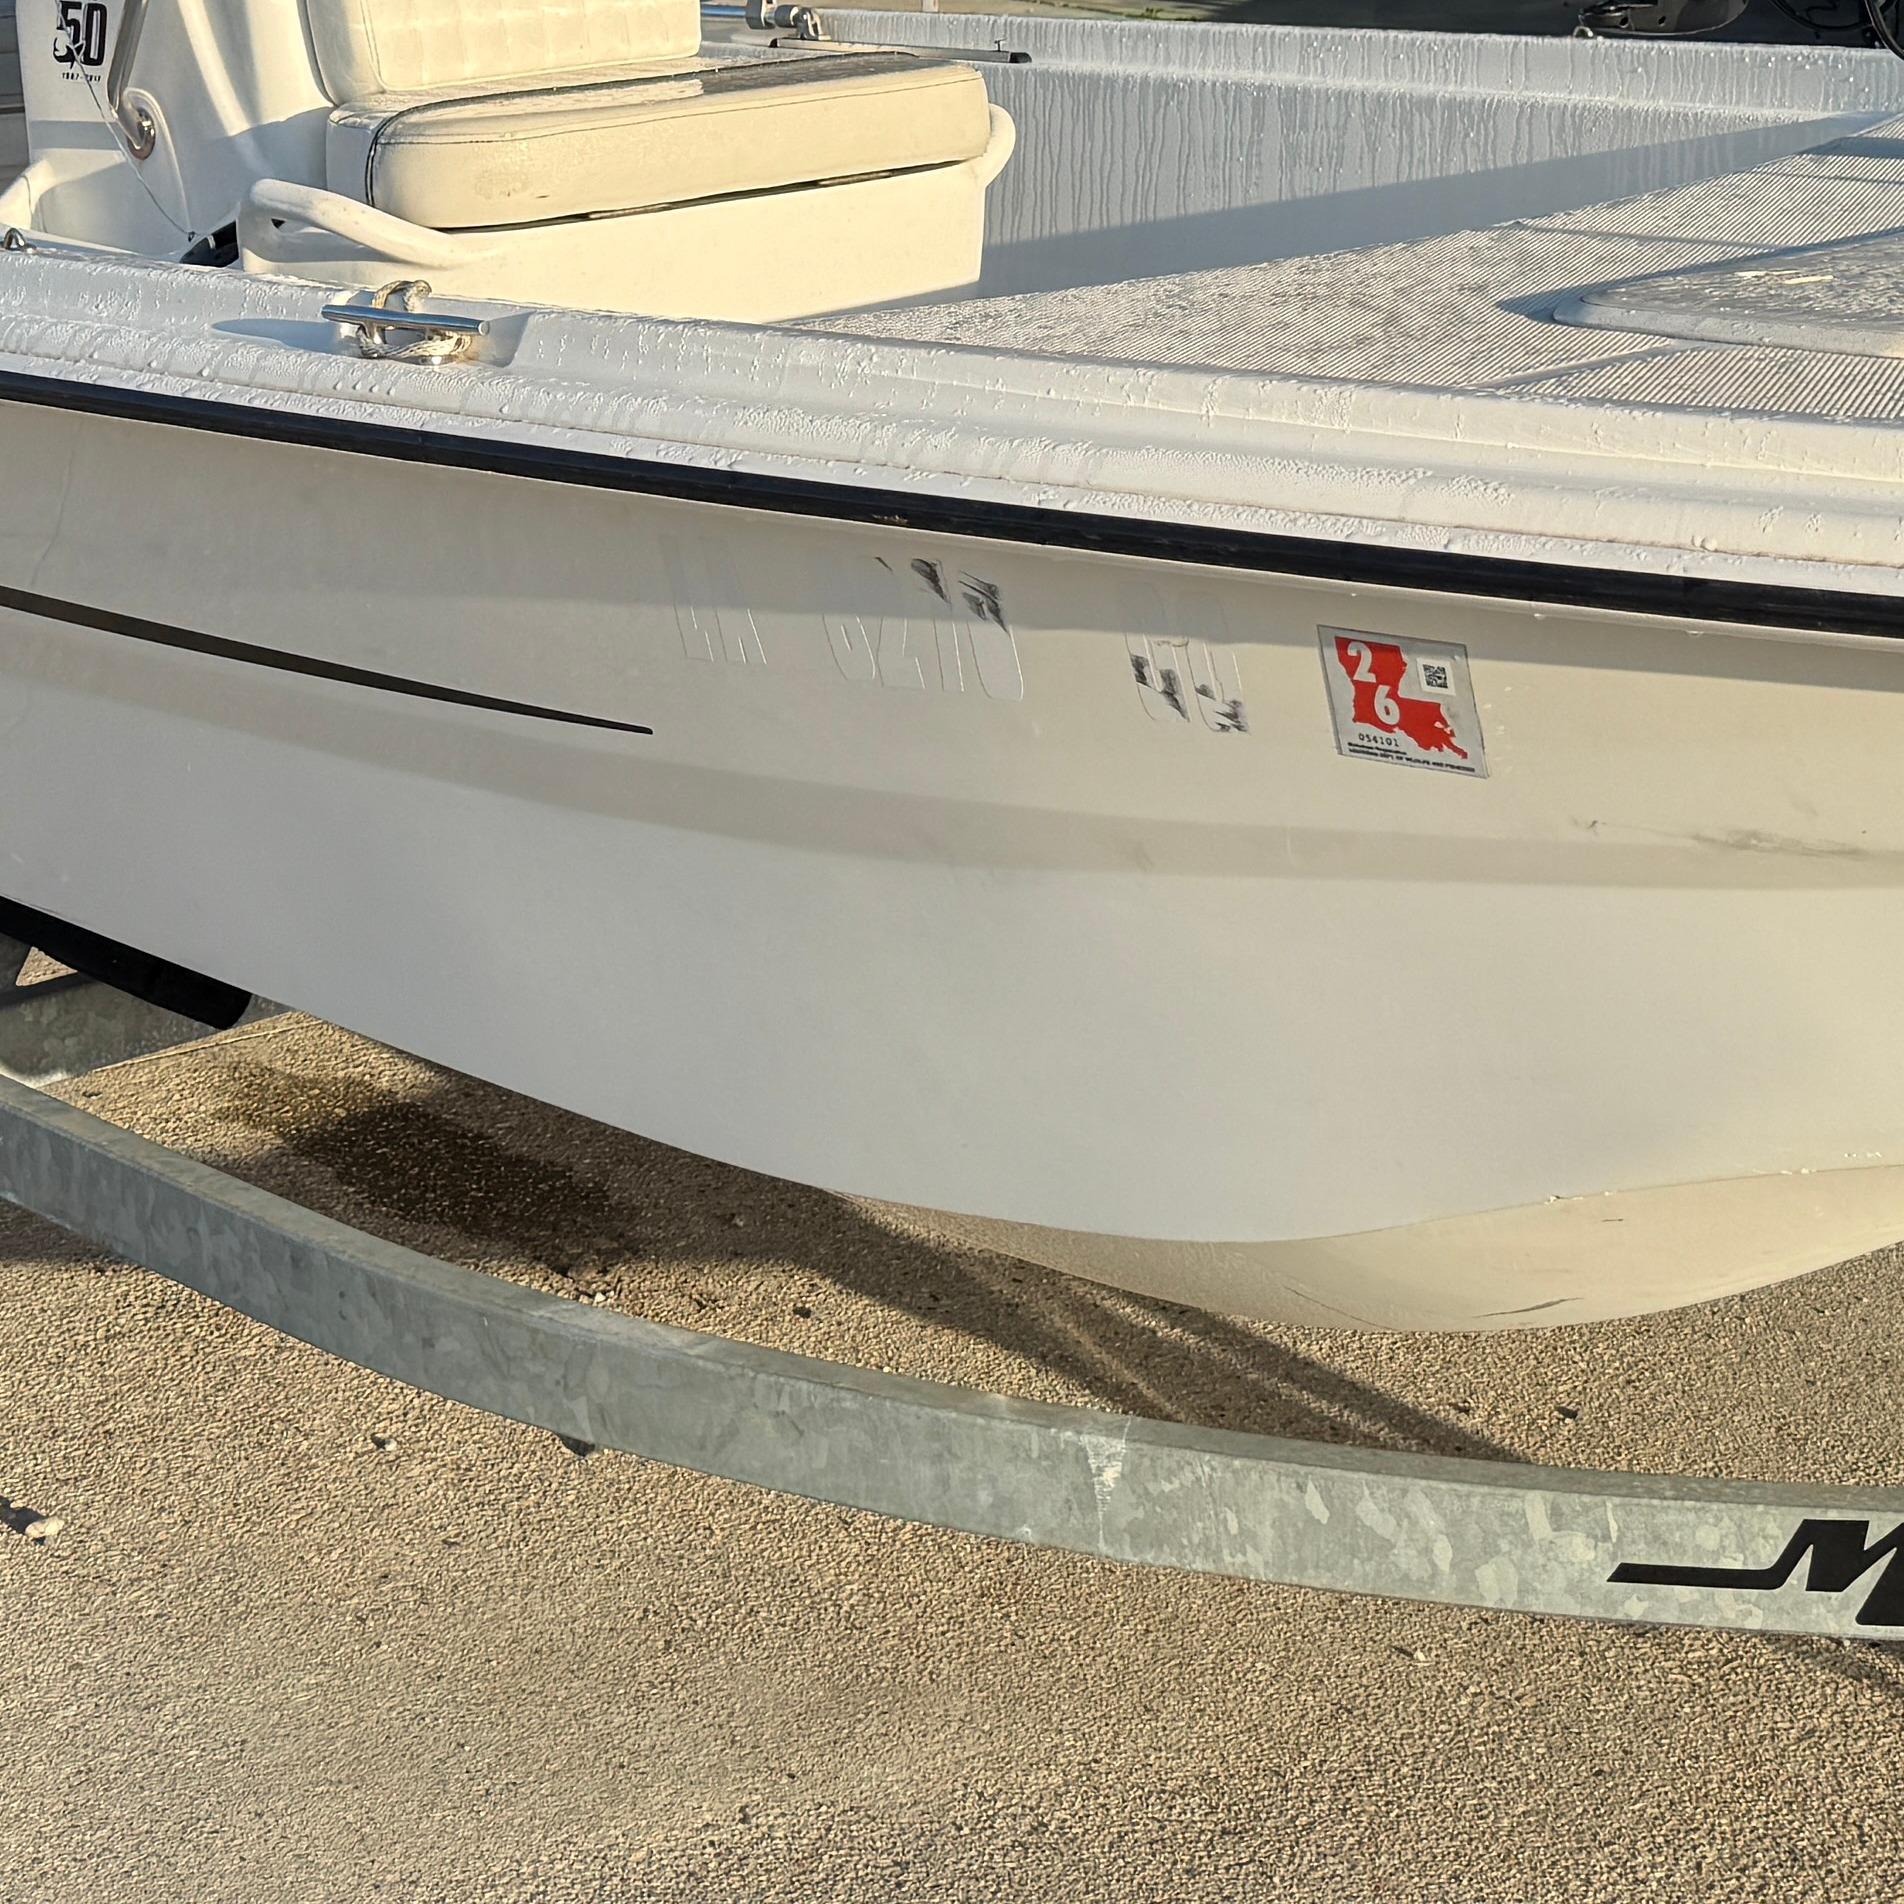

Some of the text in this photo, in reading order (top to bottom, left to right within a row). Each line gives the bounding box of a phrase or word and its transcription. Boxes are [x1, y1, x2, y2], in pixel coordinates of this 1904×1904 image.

[56, 0, 108, 67] 50
[1348, 641, 1376, 683] 2
[1374, 685, 1400, 725] 6
